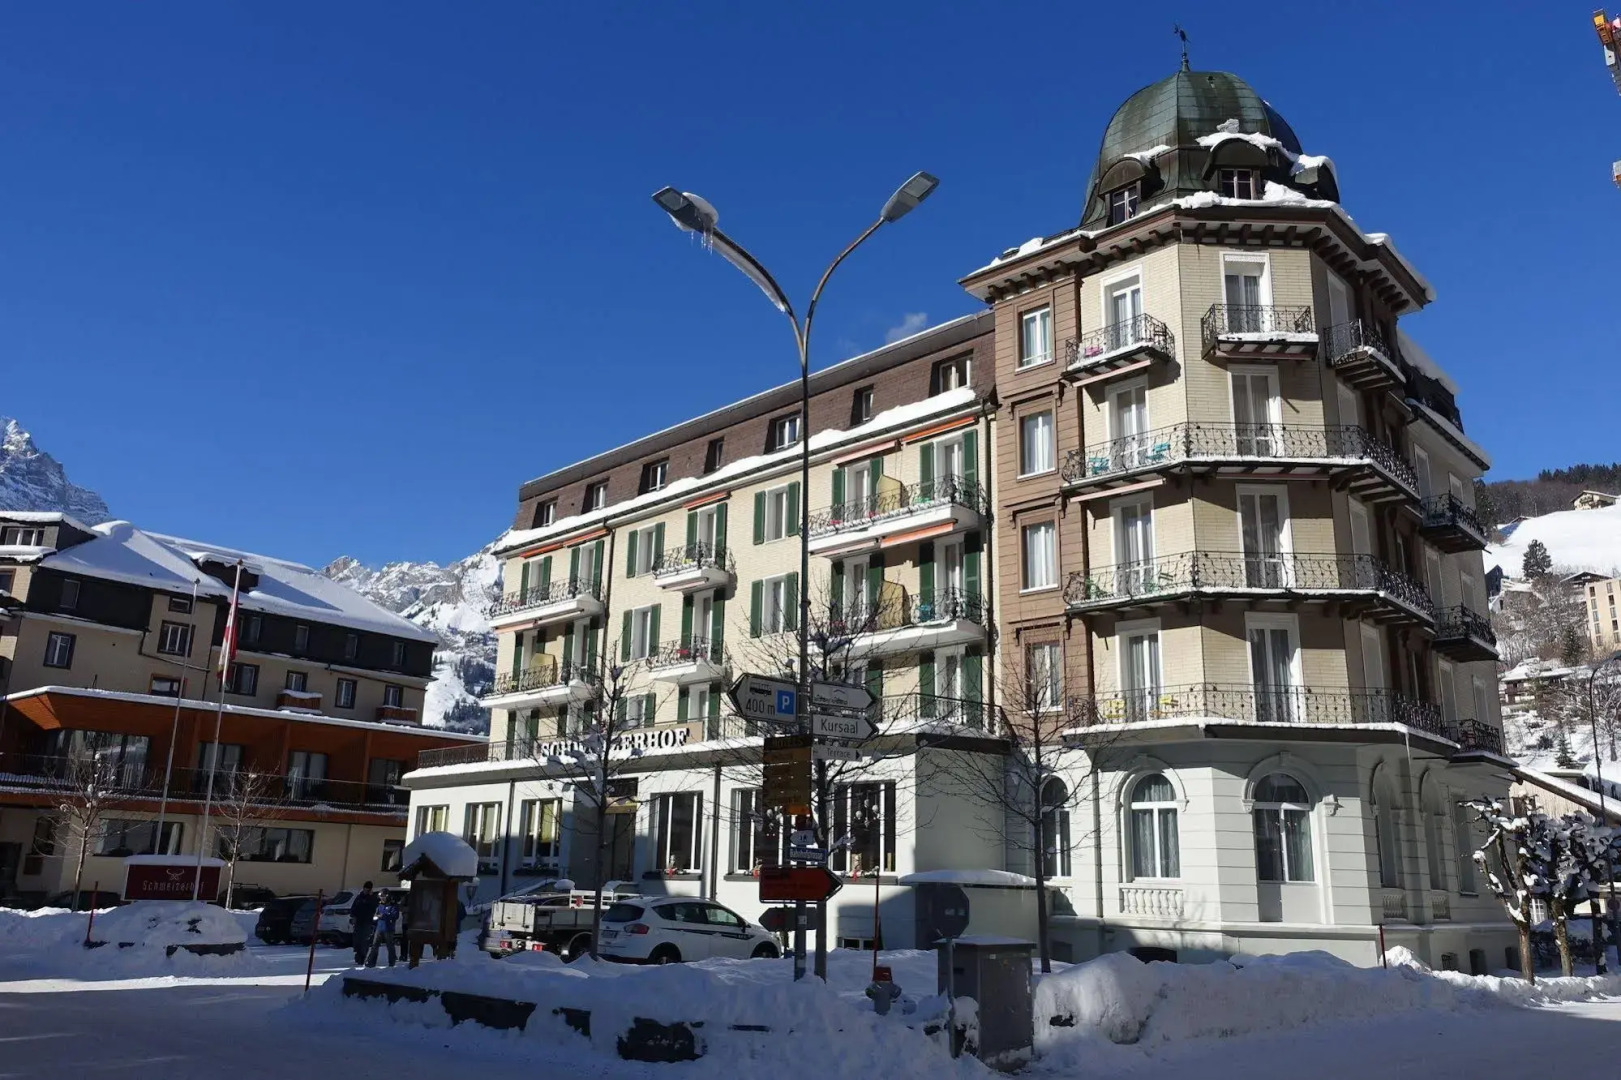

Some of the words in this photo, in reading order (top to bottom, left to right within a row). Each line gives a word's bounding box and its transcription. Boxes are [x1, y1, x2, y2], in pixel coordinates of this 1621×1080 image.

[745, 698, 765, 713] 400
[767, 704, 776, 716] m
[782, 695, 790, 710] P
[820, 718, 859, 735] Kursaal
[827, 747, 851, 759] Terrace
[142, 880, 206, 895] Schweizerhf
